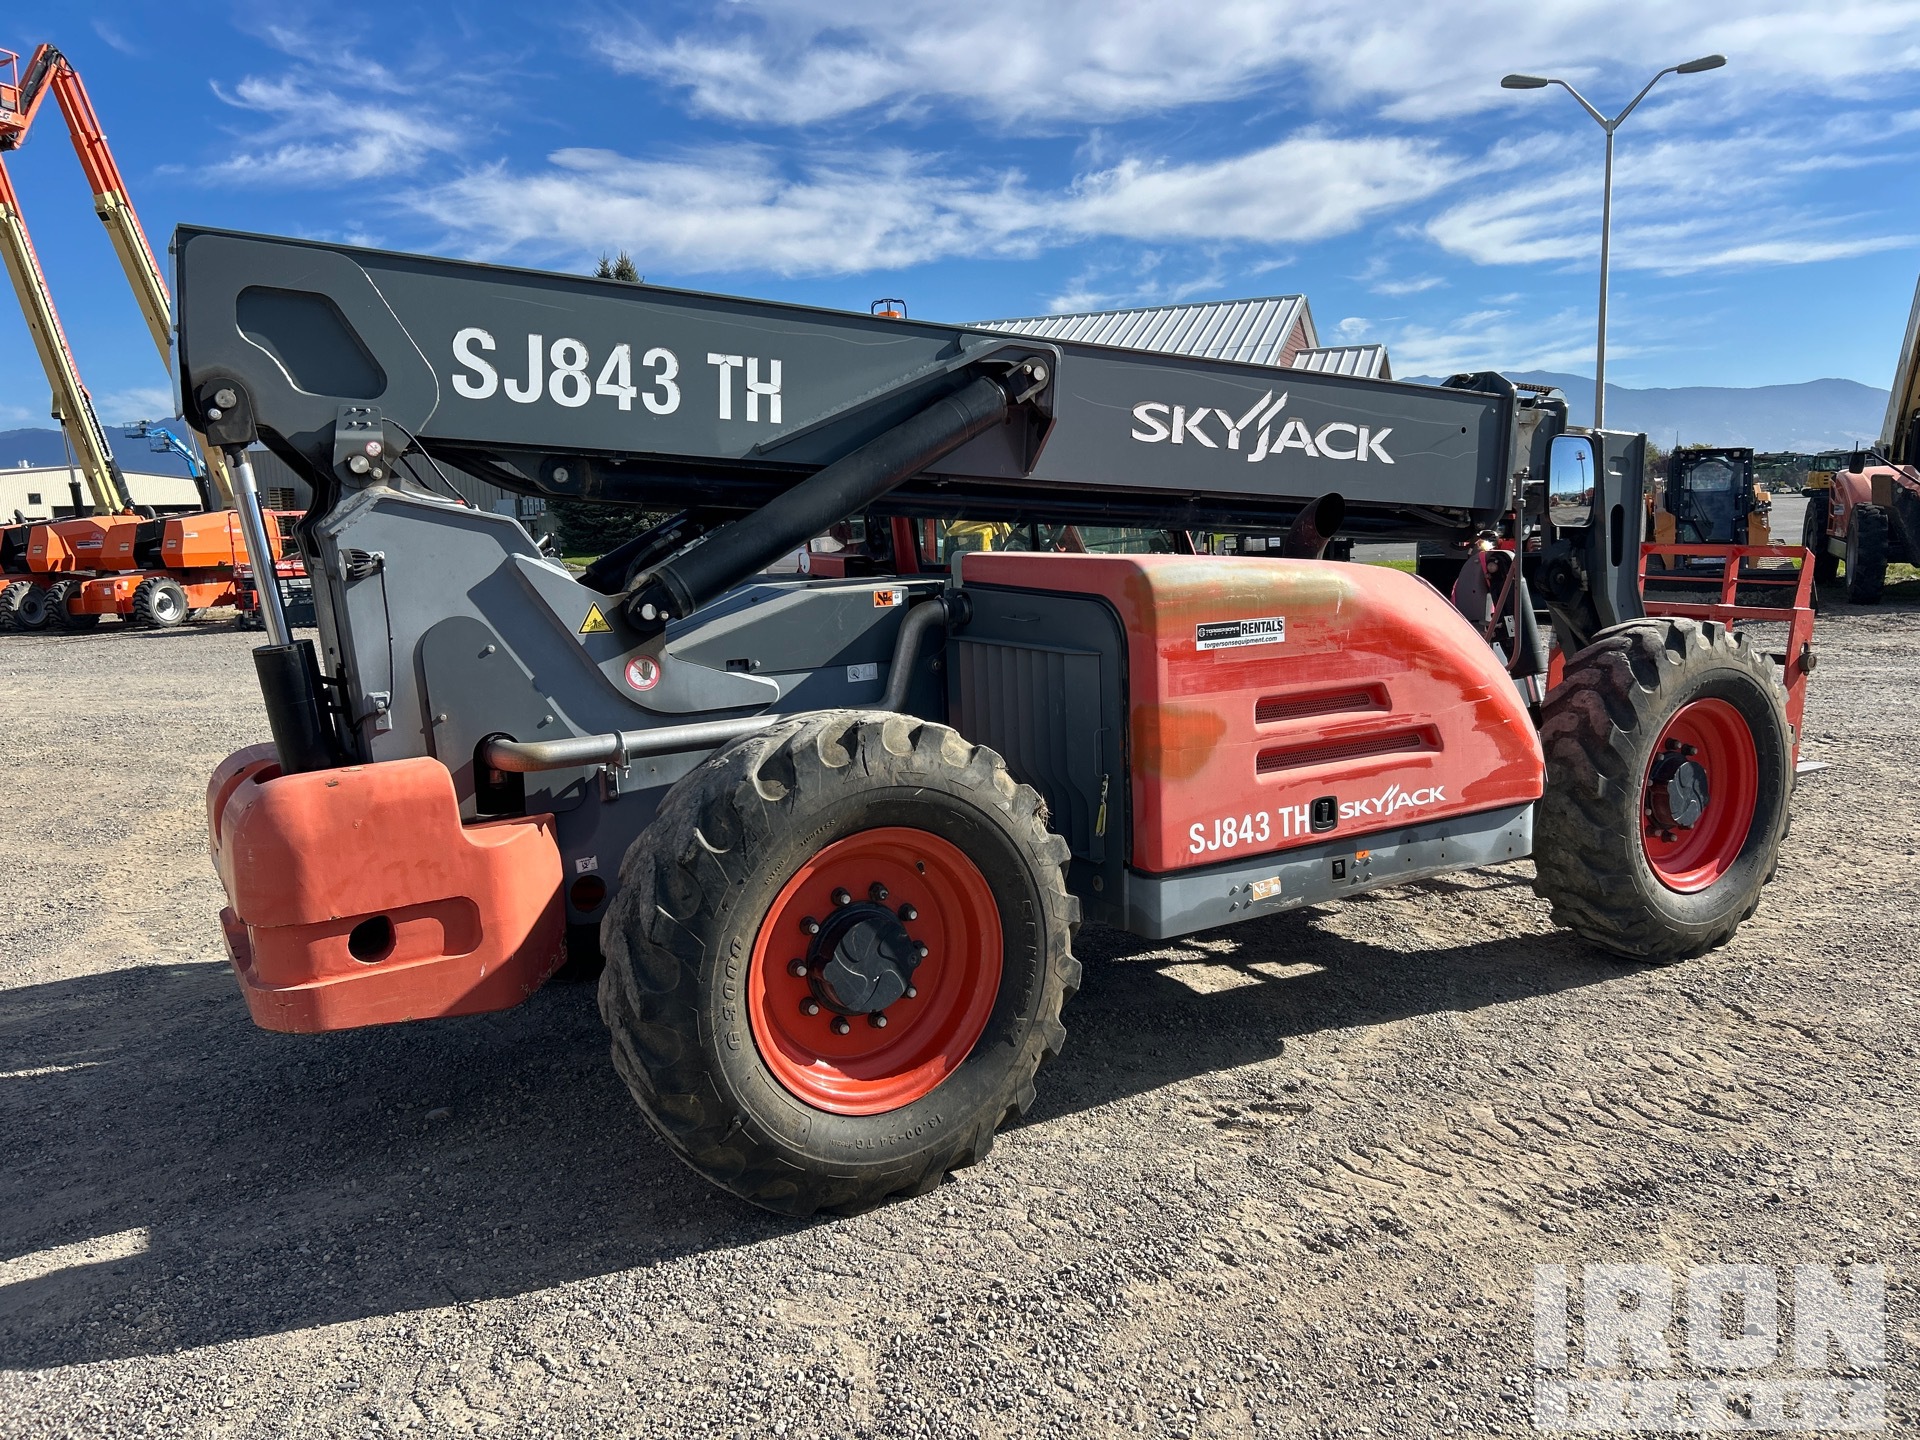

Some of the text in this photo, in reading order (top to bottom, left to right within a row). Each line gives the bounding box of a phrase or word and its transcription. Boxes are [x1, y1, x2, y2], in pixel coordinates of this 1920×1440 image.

[452, 327, 782, 424] SJ843 TH
[1131, 389, 1395, 464] SKYJACK
[1204, 635, 1278, 649] torgersonsequipment.com
[1241, 620, 1283, 635] RENTALS
[1339, 784, 1446, 820] SKYJACK
[1189, 803, 1311, 854] SJ843 TH
